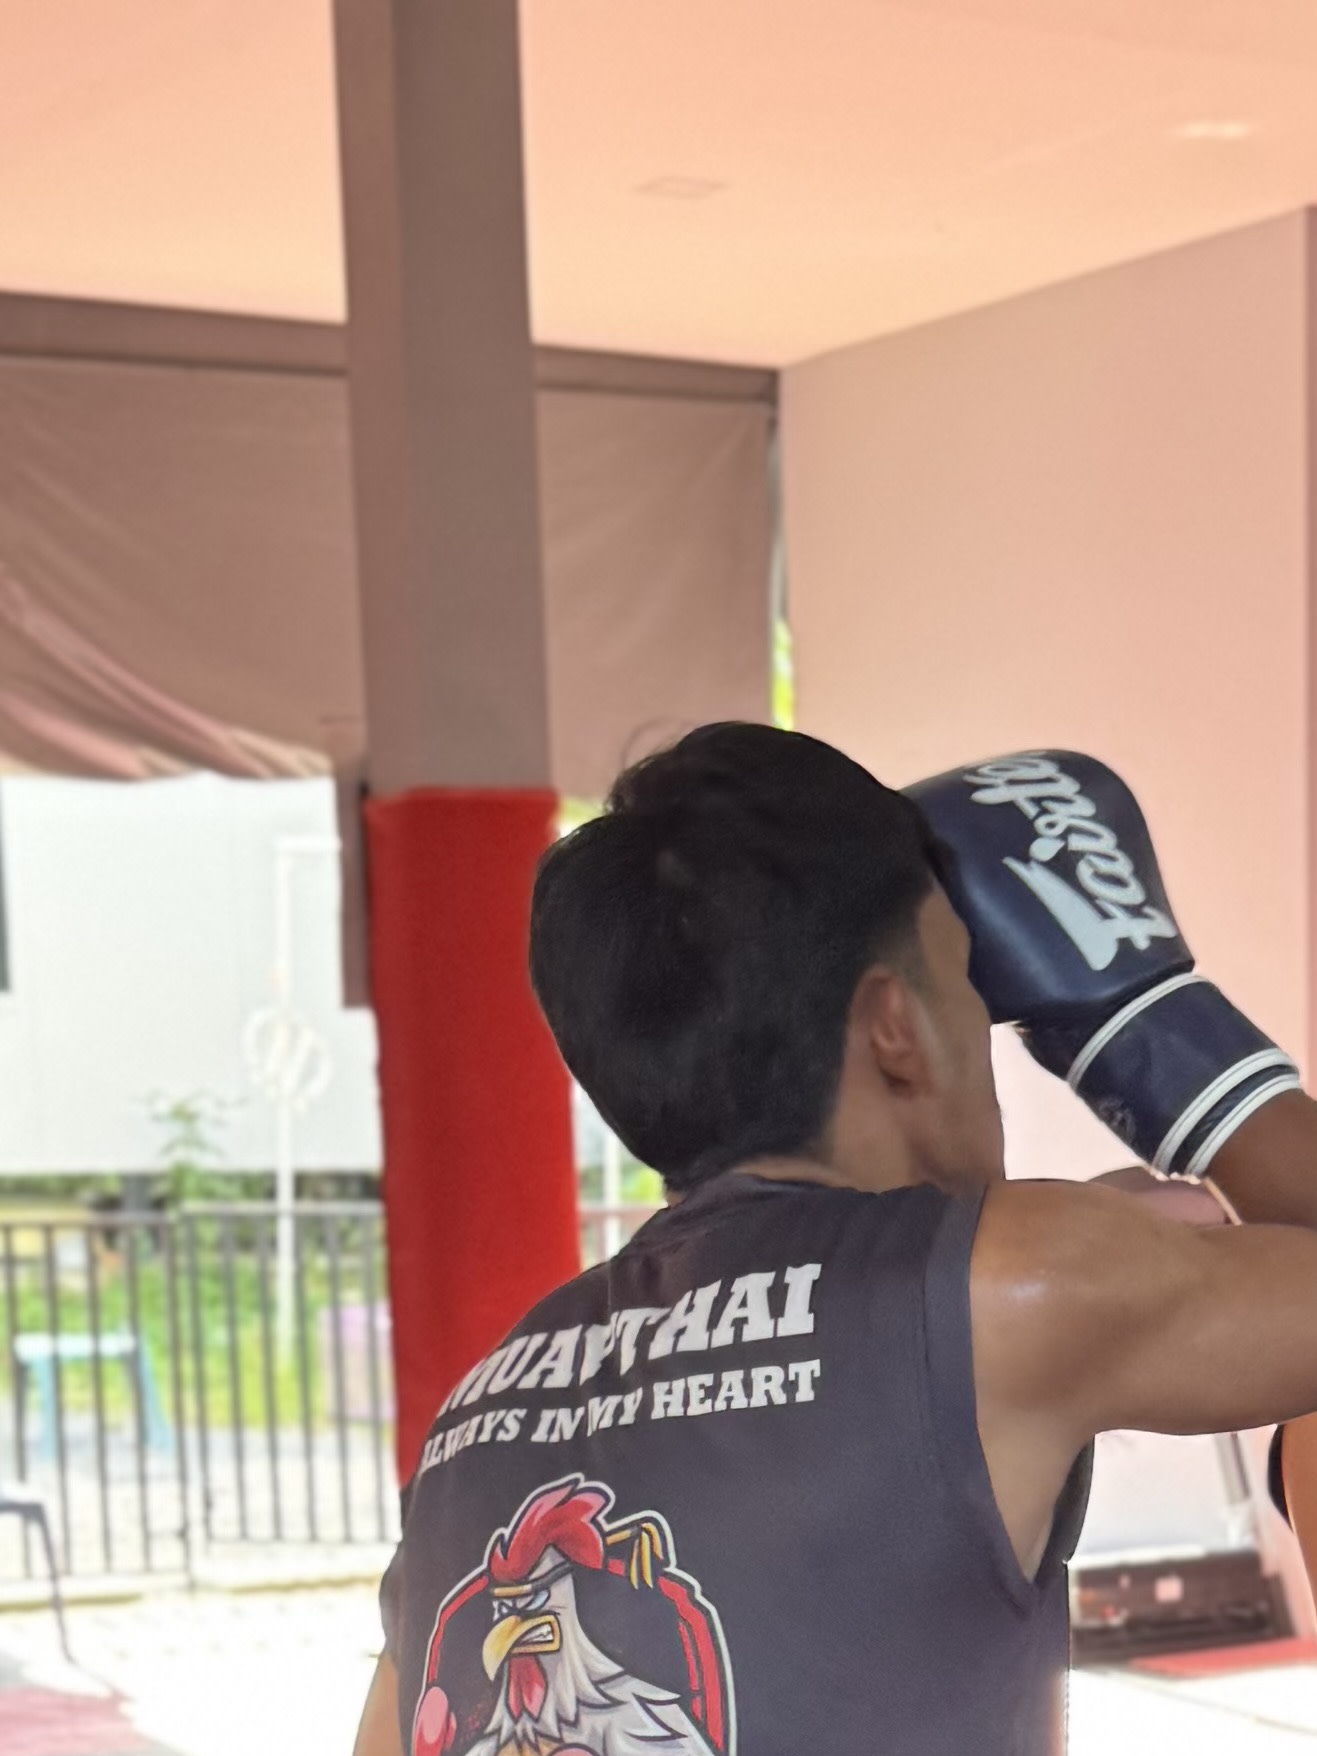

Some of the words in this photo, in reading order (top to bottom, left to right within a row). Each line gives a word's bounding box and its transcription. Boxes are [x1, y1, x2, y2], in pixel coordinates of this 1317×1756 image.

[530, 1406, 586, 1443] IN
[587, 1387, 643, 1437] MY
[650, 1358, 821, 1421] HEART
